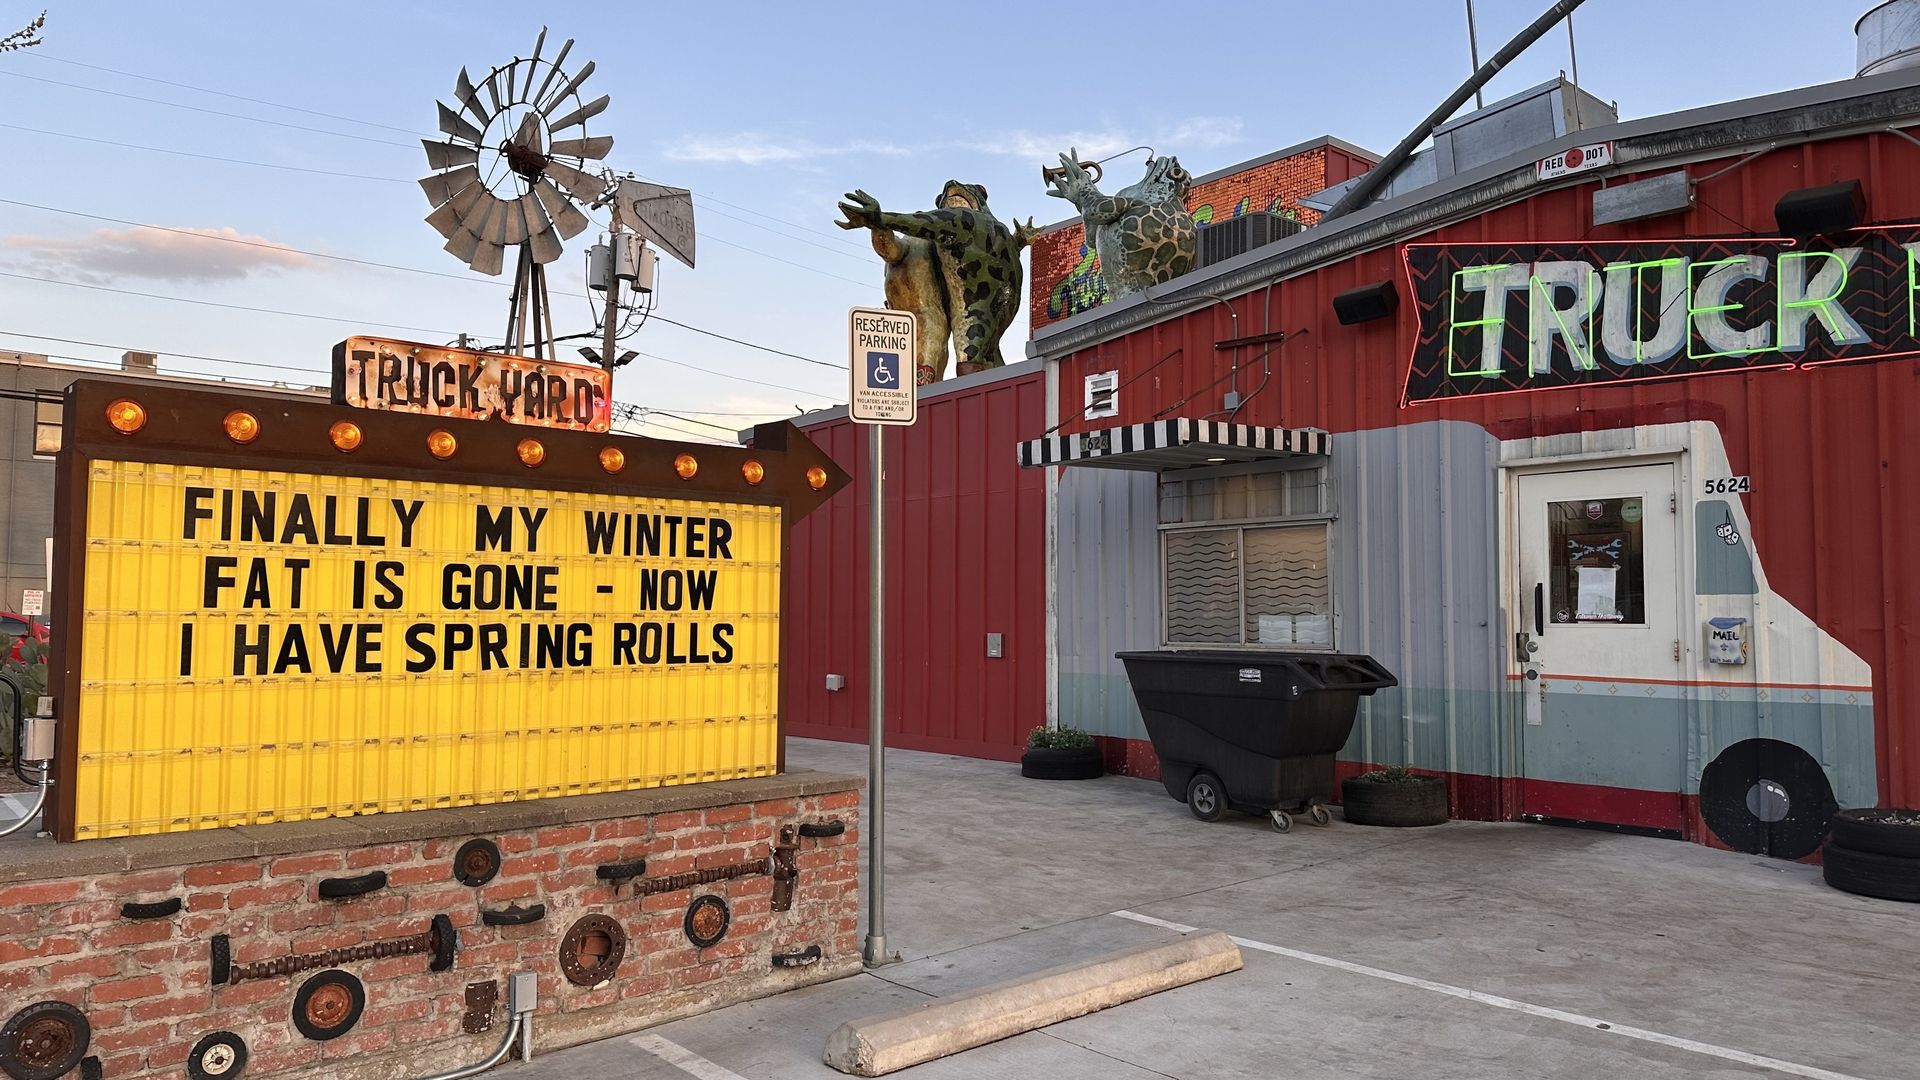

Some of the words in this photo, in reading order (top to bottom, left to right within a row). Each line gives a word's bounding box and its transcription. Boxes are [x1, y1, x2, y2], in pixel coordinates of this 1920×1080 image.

[1545, 157, 1563, 171] RED
[1585, 146, 1604, 161] DOT
[1584, 161, 1598, 169] TEXAS
[1461, 246, 1873, 380] TRUCK
[856, 317, 910, 335] RESERVED
[860, 333, 907, 350] PARKING
[351, 349, 487, 413] TRUCK
[500, 368, 596, 425] YARD
[871, 391, 909, 399] ACCESSIBLE
[1704, 477, 1750, 494] 5624
[183, 486, 425, 548] FINALLY
[475, 504, 549, 553] MY
[584, 510, 733, 560] WINTER
[203, 556, 311, 609] FAT
[352, 560, 405, 610] IS
[442, 563, 559, 611] GONE
[640, 568, 718, 611] NOW
[1712, 630, 1740, 641] MAIL
[180, 623, 193, 676] I
[233, 623, 383, 676] HAVE
[405, 623, 593, 673] SPRING
[613, 622, 734, 666] ROLLS
